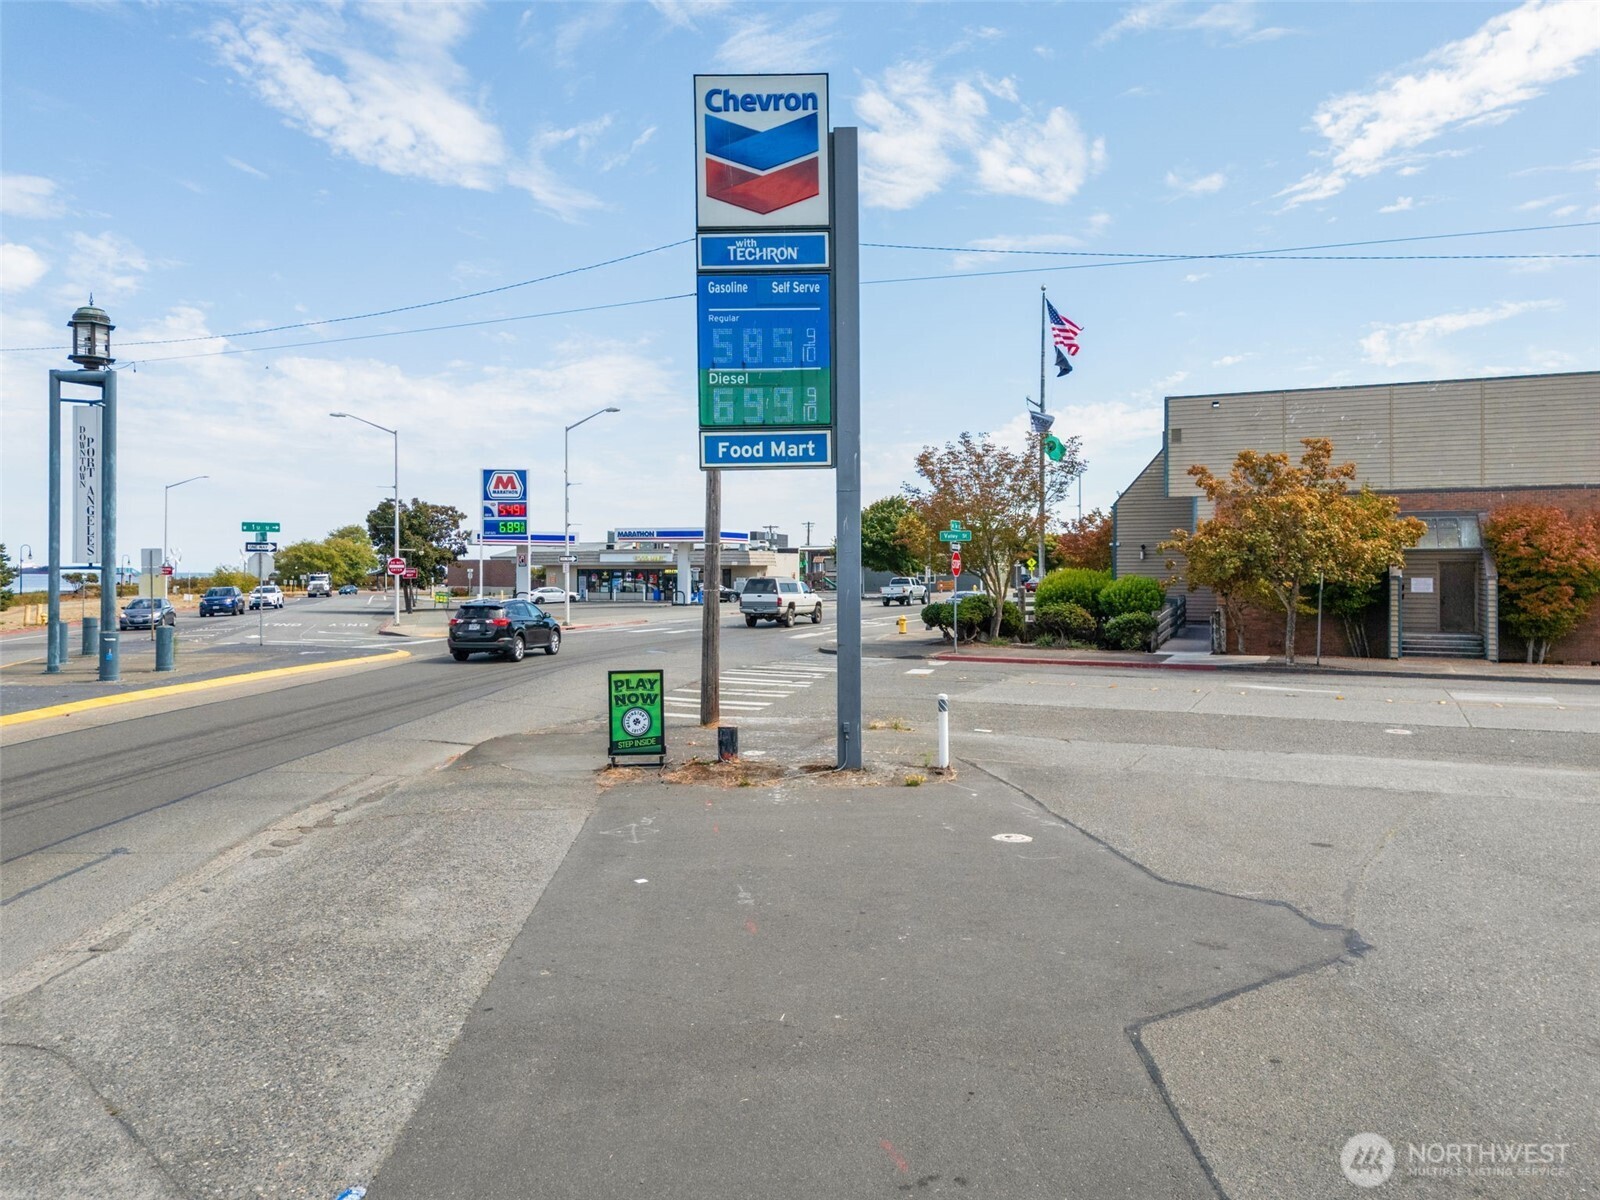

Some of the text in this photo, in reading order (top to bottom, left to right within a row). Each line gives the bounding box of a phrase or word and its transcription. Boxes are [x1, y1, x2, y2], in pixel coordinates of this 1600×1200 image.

[705, 88, 818, 113] Chevron
[736, 238, 757, 248] with
[727, 245, 798, 263] TECHRON
[708, 281, 820, 294] Gasoline Self Serve
[708, 314, 740, 323] Regular
[709, 372, 748, 384] Diesel
[718, 440, 815, 458] Food Mart
[79, 425, 87, 488] DOWNTOWN
[493, 475, 517, 489] M
[87, 437, 95, 556] PORT ANGELES
[952, 560, 961, 568] STOP
[613, 678, 659, 692] PLAY
[613, 693, 659, 706] NOW
[618, 737, 657, 749] STEP INSIDE
